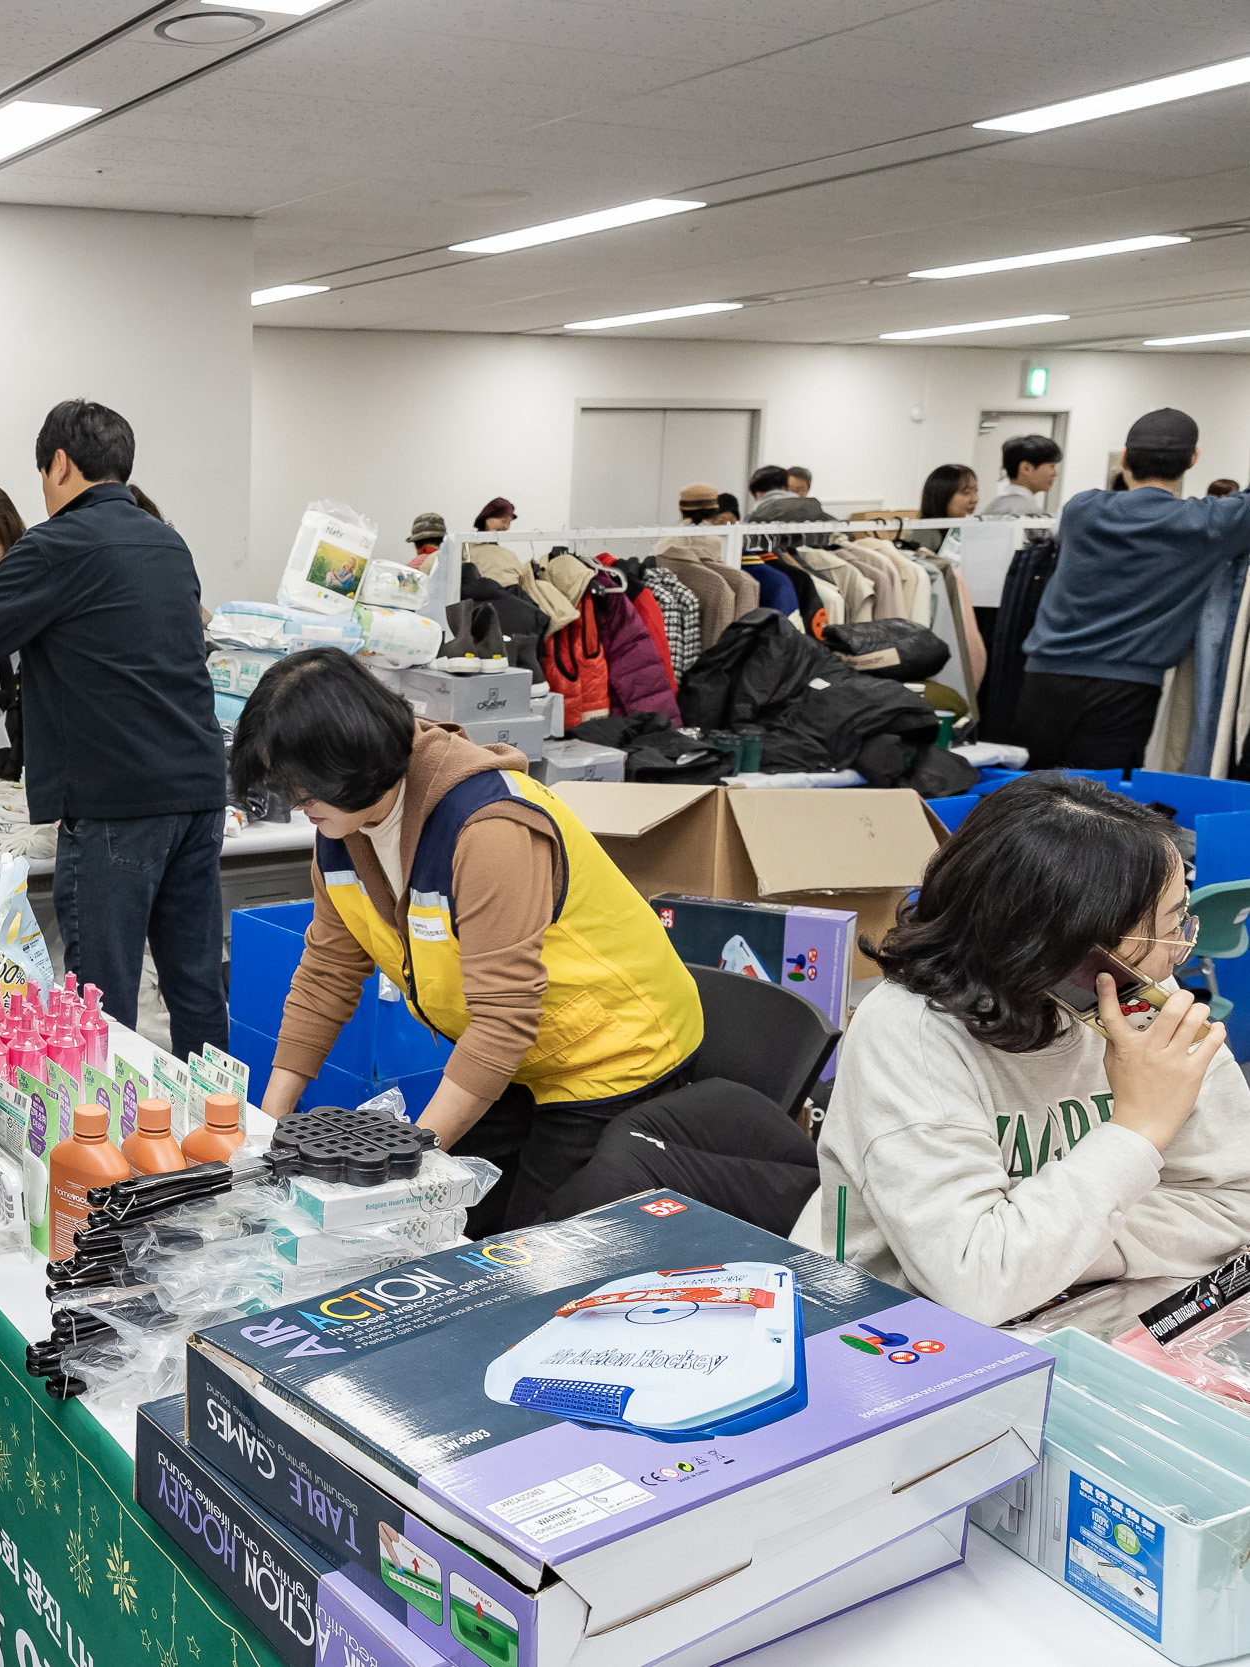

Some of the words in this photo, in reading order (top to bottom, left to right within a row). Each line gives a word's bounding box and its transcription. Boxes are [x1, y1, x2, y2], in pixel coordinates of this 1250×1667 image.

[643, 1201, 674, 1216] 5+
[240, 1317, 347, 1359] AIR
[297, 1267, 456, 1331] ACTION
[455, 1224, 612, 1273] HOCKEY
[323, 1325, 354, 1336] The
[353, 1312, 390, 1327] best
[389, 1289, 458, 1315] welcome
[459, 1278, 488, 1292] gifts
[354, 1328, 392, 1343] anytime
[392, 1320, 411, 1331] you
[411, 1313, 434, 1323] want
[361, 1333, 396, 1347] Perfect
[413, 1322, 427, 1330] for
[450, 1306, 474, 1317] adult
[474, 1299, 493, 1308] and
[365, 1320, 393, 1333] place
[393, 1314, 413, 1322] one
[424, 1302, 444, 1312] your
[444, 1293, 470, 1305] office
[566, 1348, 637, 1367] Action
[631, 1349, 729, 1376] Hockey
[206, 1382, 231, 1409] sound
[206, 1398, 276, 1480] GAMES
[257, 1428, 276, 1449] and
[158, 1451, 193, 1491] sound
[277, 1443, 312, 1477] lighting
[195, 1488, 230, 1532] lifelike
[288, 1467, 362, 1555] TABLE
[314, 1474, 358, 1516] Beautiful
[1079, 1489, 1103, 1508] MAGNET
[1103, 1504, 1112, 1513] TO
[1111, 1510, 1135, 1528] OBJECT
[158, 1467, 236, 1573] HOCKEY
[233, 1524, 260, 1556] and
[1091, 1511, 1109, 1529] 100%
[262, 1548, 311, 1610] lighting
[23, 1557, 62, 1649] 광진
[245, 1549, 330, 1662] ACTION
